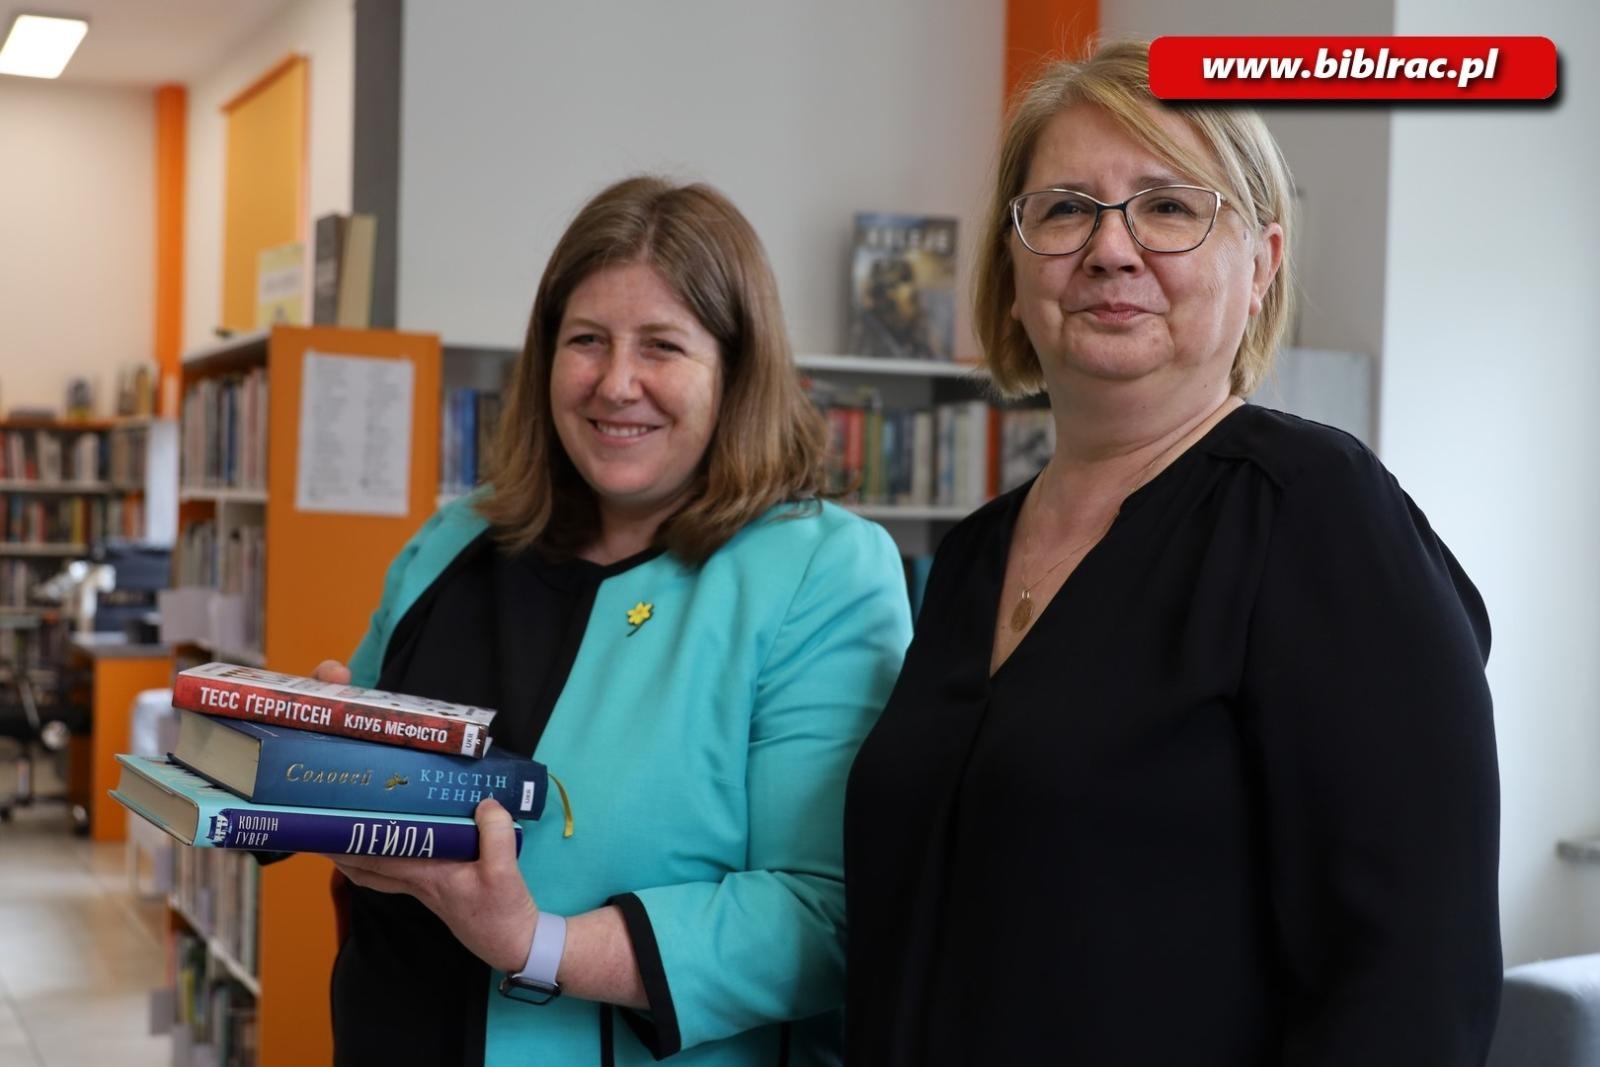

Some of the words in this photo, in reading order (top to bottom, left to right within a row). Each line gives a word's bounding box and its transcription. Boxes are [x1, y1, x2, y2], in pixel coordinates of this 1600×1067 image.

[200, 686, 240, 710] ТЕСС
[245, 693, 332, 726] ҐЕРРІТСЕН
[344, 713, 382, 733] КЛУБ
[384, 720, 448, 744] МЕФІСТО
[420, 769, 508, 789] КРІСТІН
[238, 815, 279, 832] КОЛЛІН
[235, 831, 269, 846] ГУВЕР
[345, 820, 434, 858] ЛЕЙЛА
